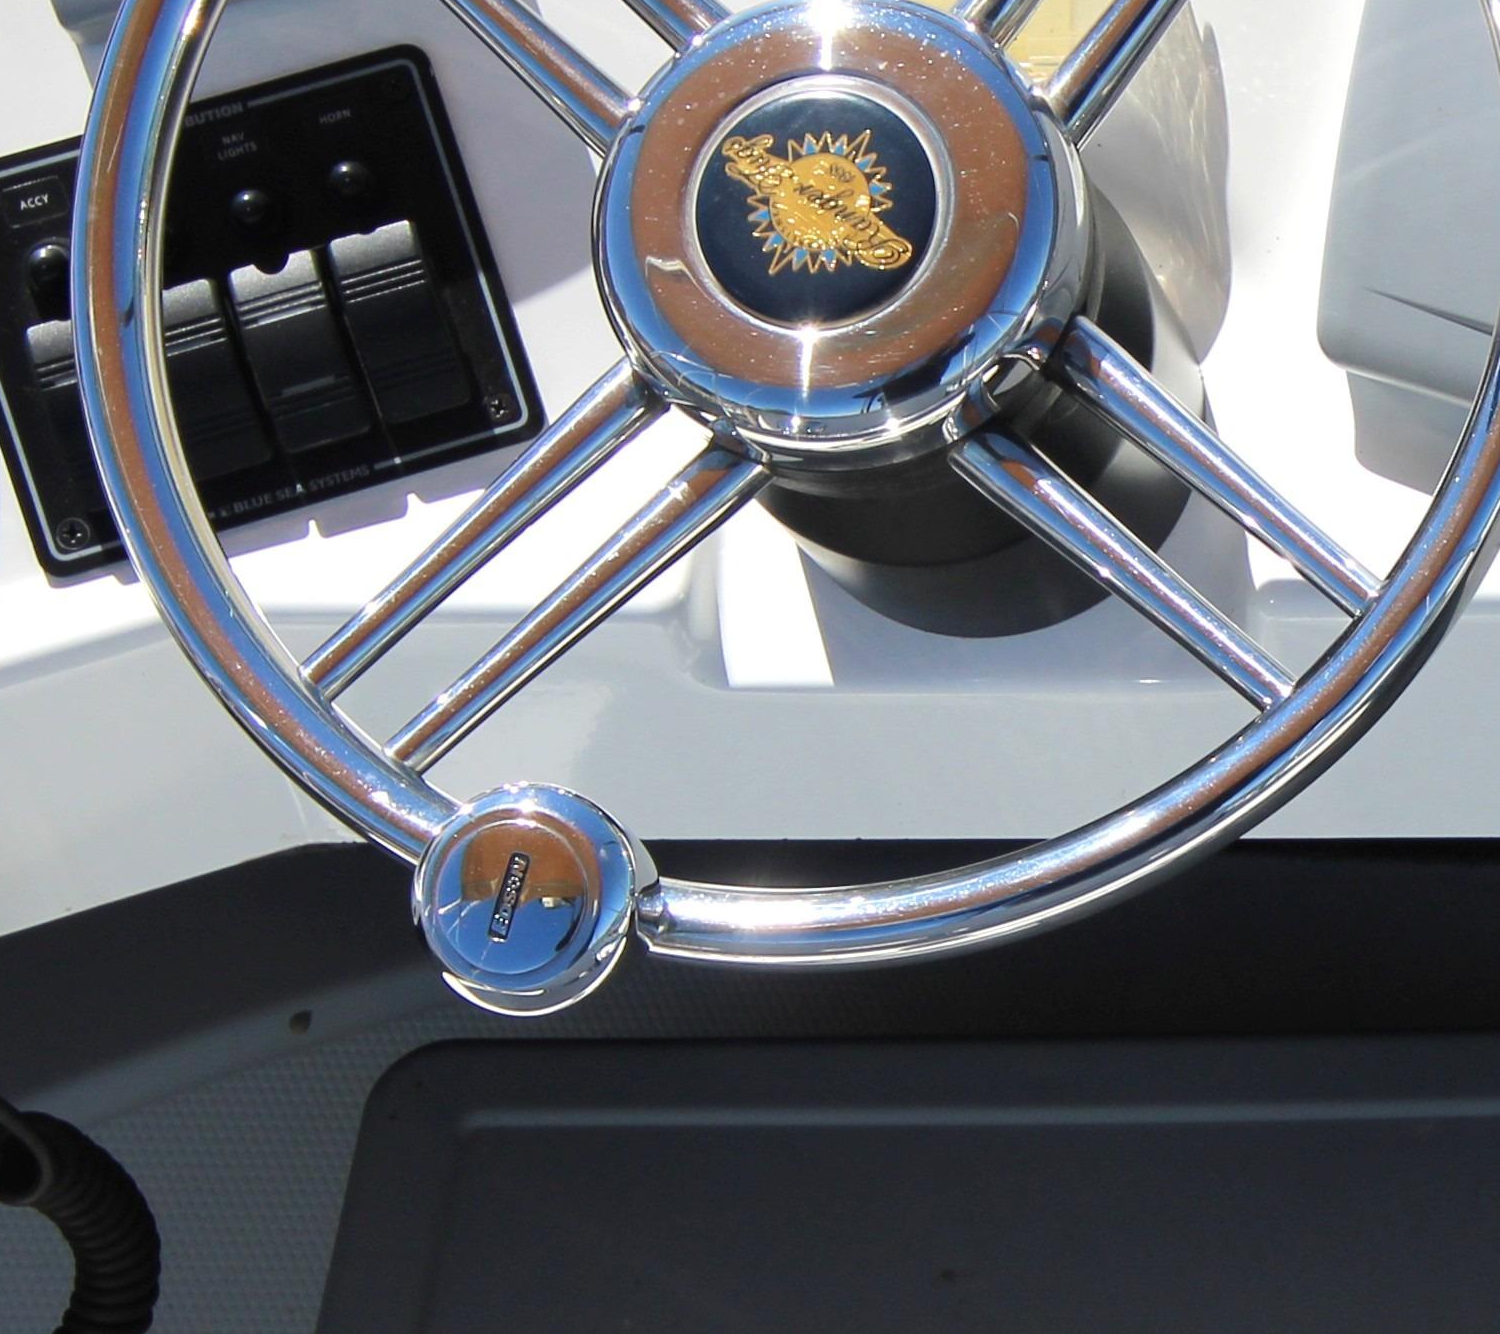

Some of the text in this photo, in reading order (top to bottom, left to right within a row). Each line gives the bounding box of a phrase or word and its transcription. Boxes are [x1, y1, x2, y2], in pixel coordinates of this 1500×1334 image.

[184, 102, 245, 129] BUTION
[318, 107, 353, 127] HORN
[220, 132, 246, 147] NAV
[216, 140, 259, 161] LIGHTS
[20, 192, 49, 212] ACCY
[232, 465, 370, 514] BLUE SEA SYSTEMS
